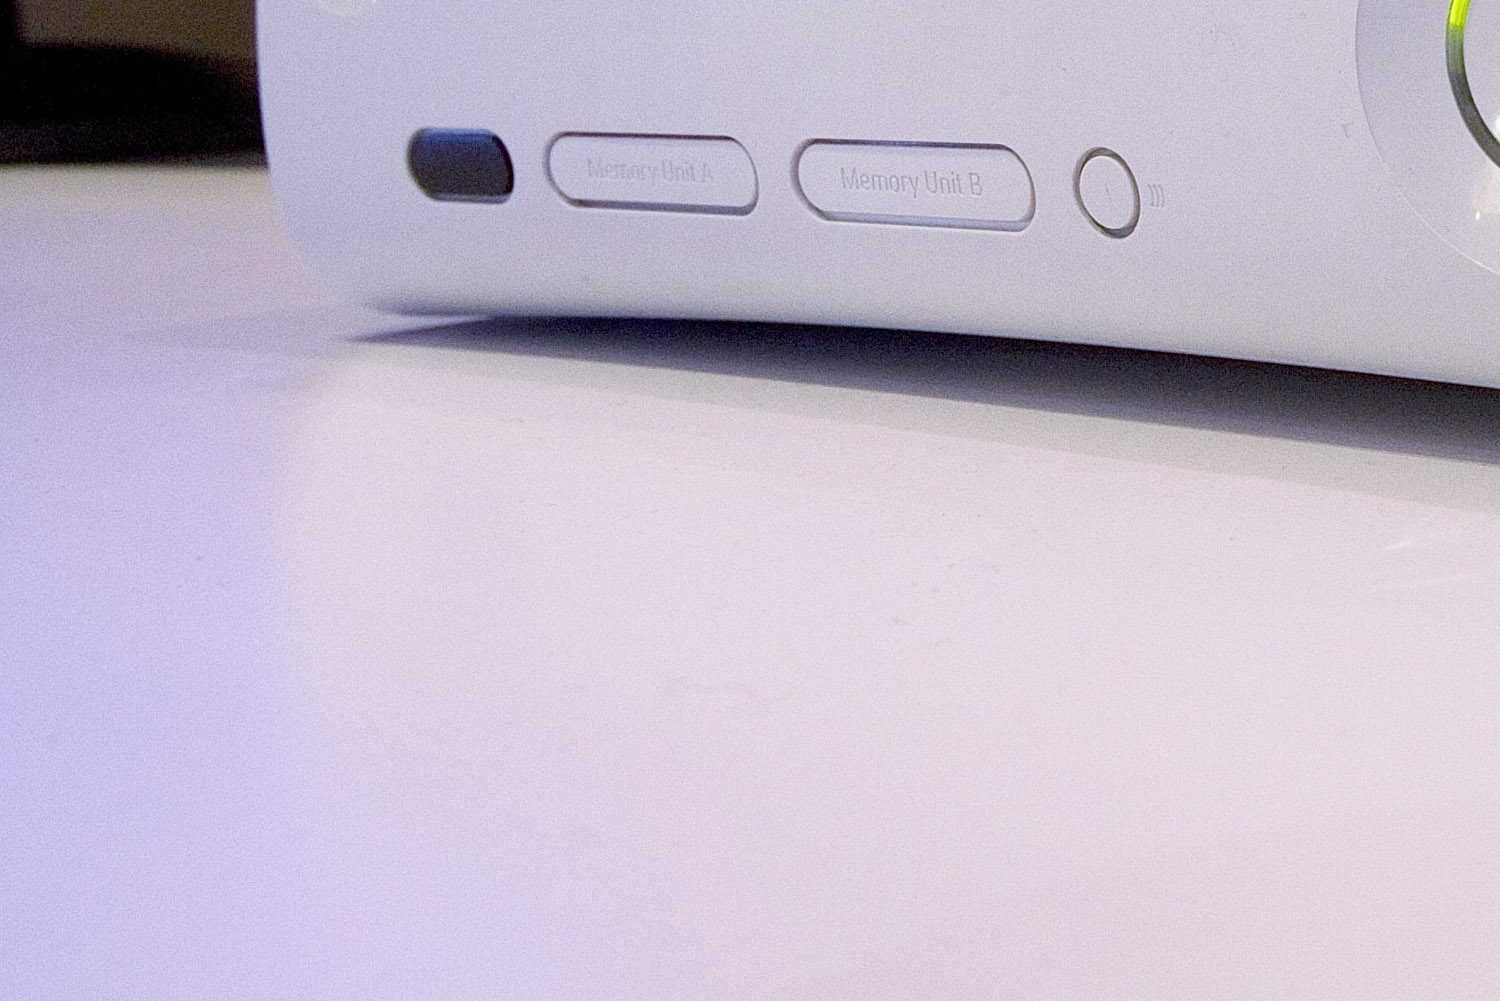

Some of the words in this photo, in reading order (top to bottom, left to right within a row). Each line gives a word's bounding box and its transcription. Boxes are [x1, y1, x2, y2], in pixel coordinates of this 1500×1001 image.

[588, 158, 656, 186] Memory
[661, 161, 697, 183] Unit
[702, 163, 715, 184] A
[841, 167, 919, 198] Memory
[924, 171, 966, 195] Unit
[970, 173, 983, 197] B
